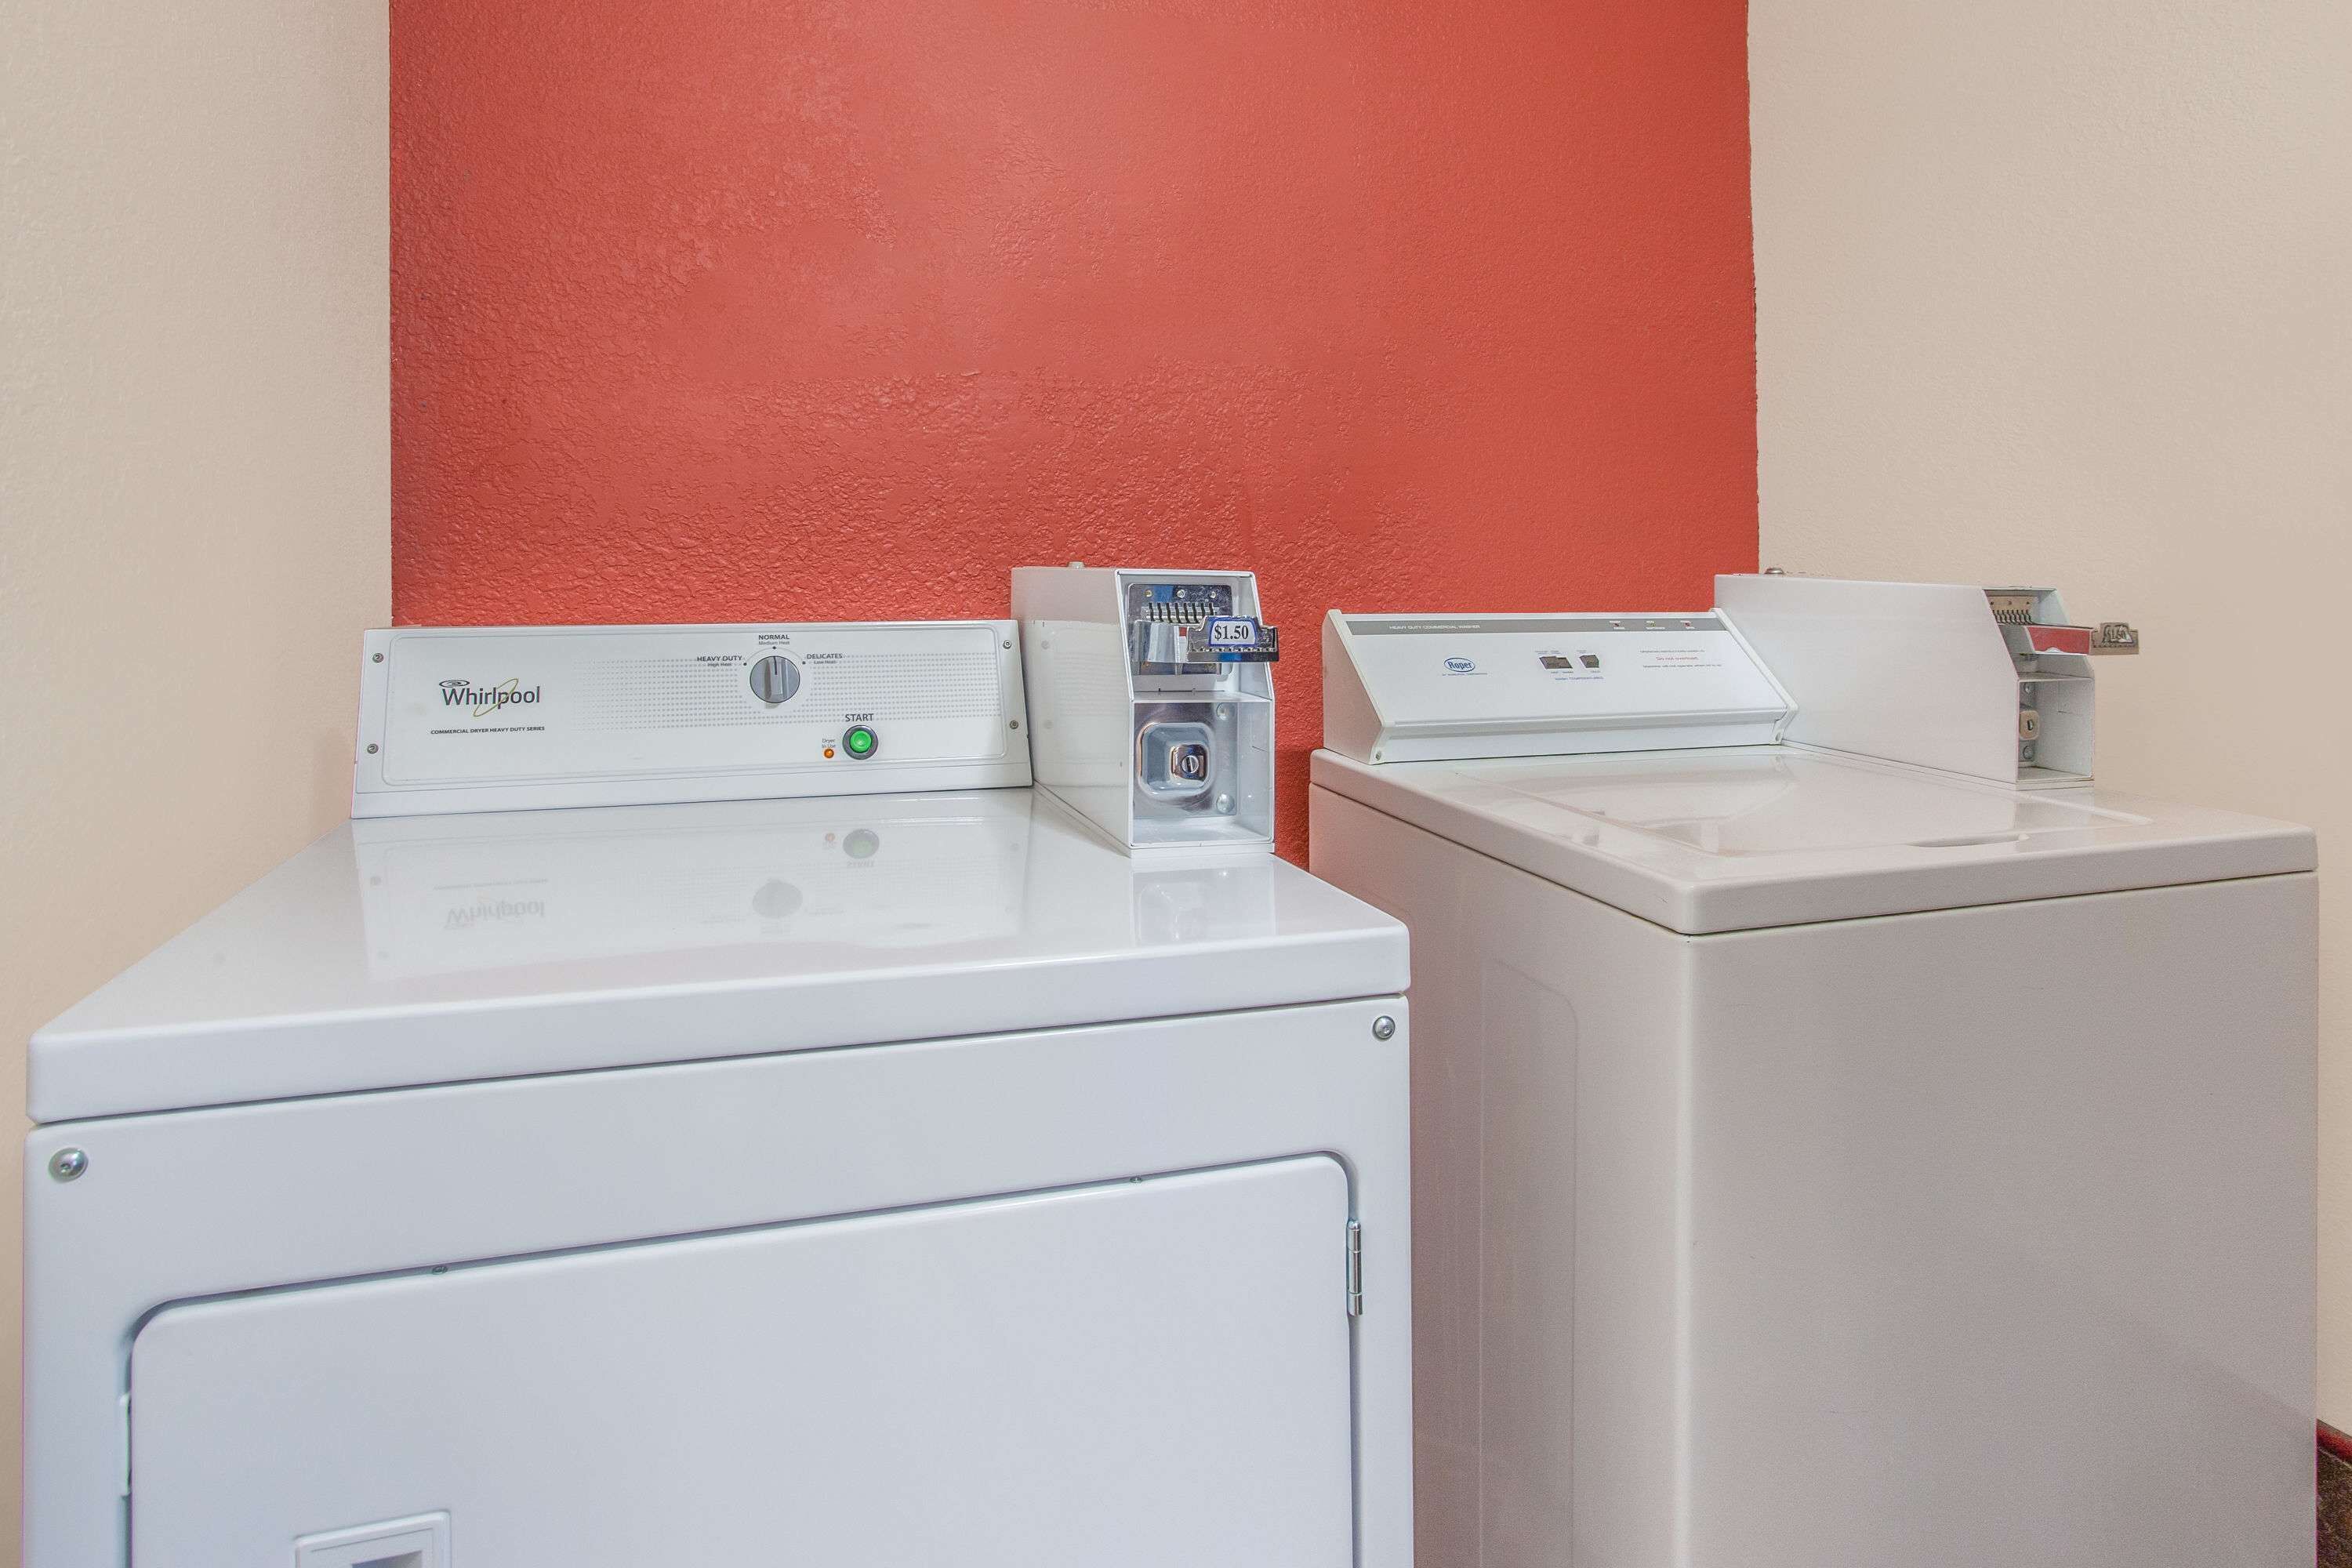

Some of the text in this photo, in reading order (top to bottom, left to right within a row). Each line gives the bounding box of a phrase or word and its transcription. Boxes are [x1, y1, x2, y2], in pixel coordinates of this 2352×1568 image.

[1214, 623, 1248, 641] $1.50
[1446, 661, 1473, 670] Roper
[441, 686, 540, 710] Whirlpool
[844, 713, 874, 722] START
